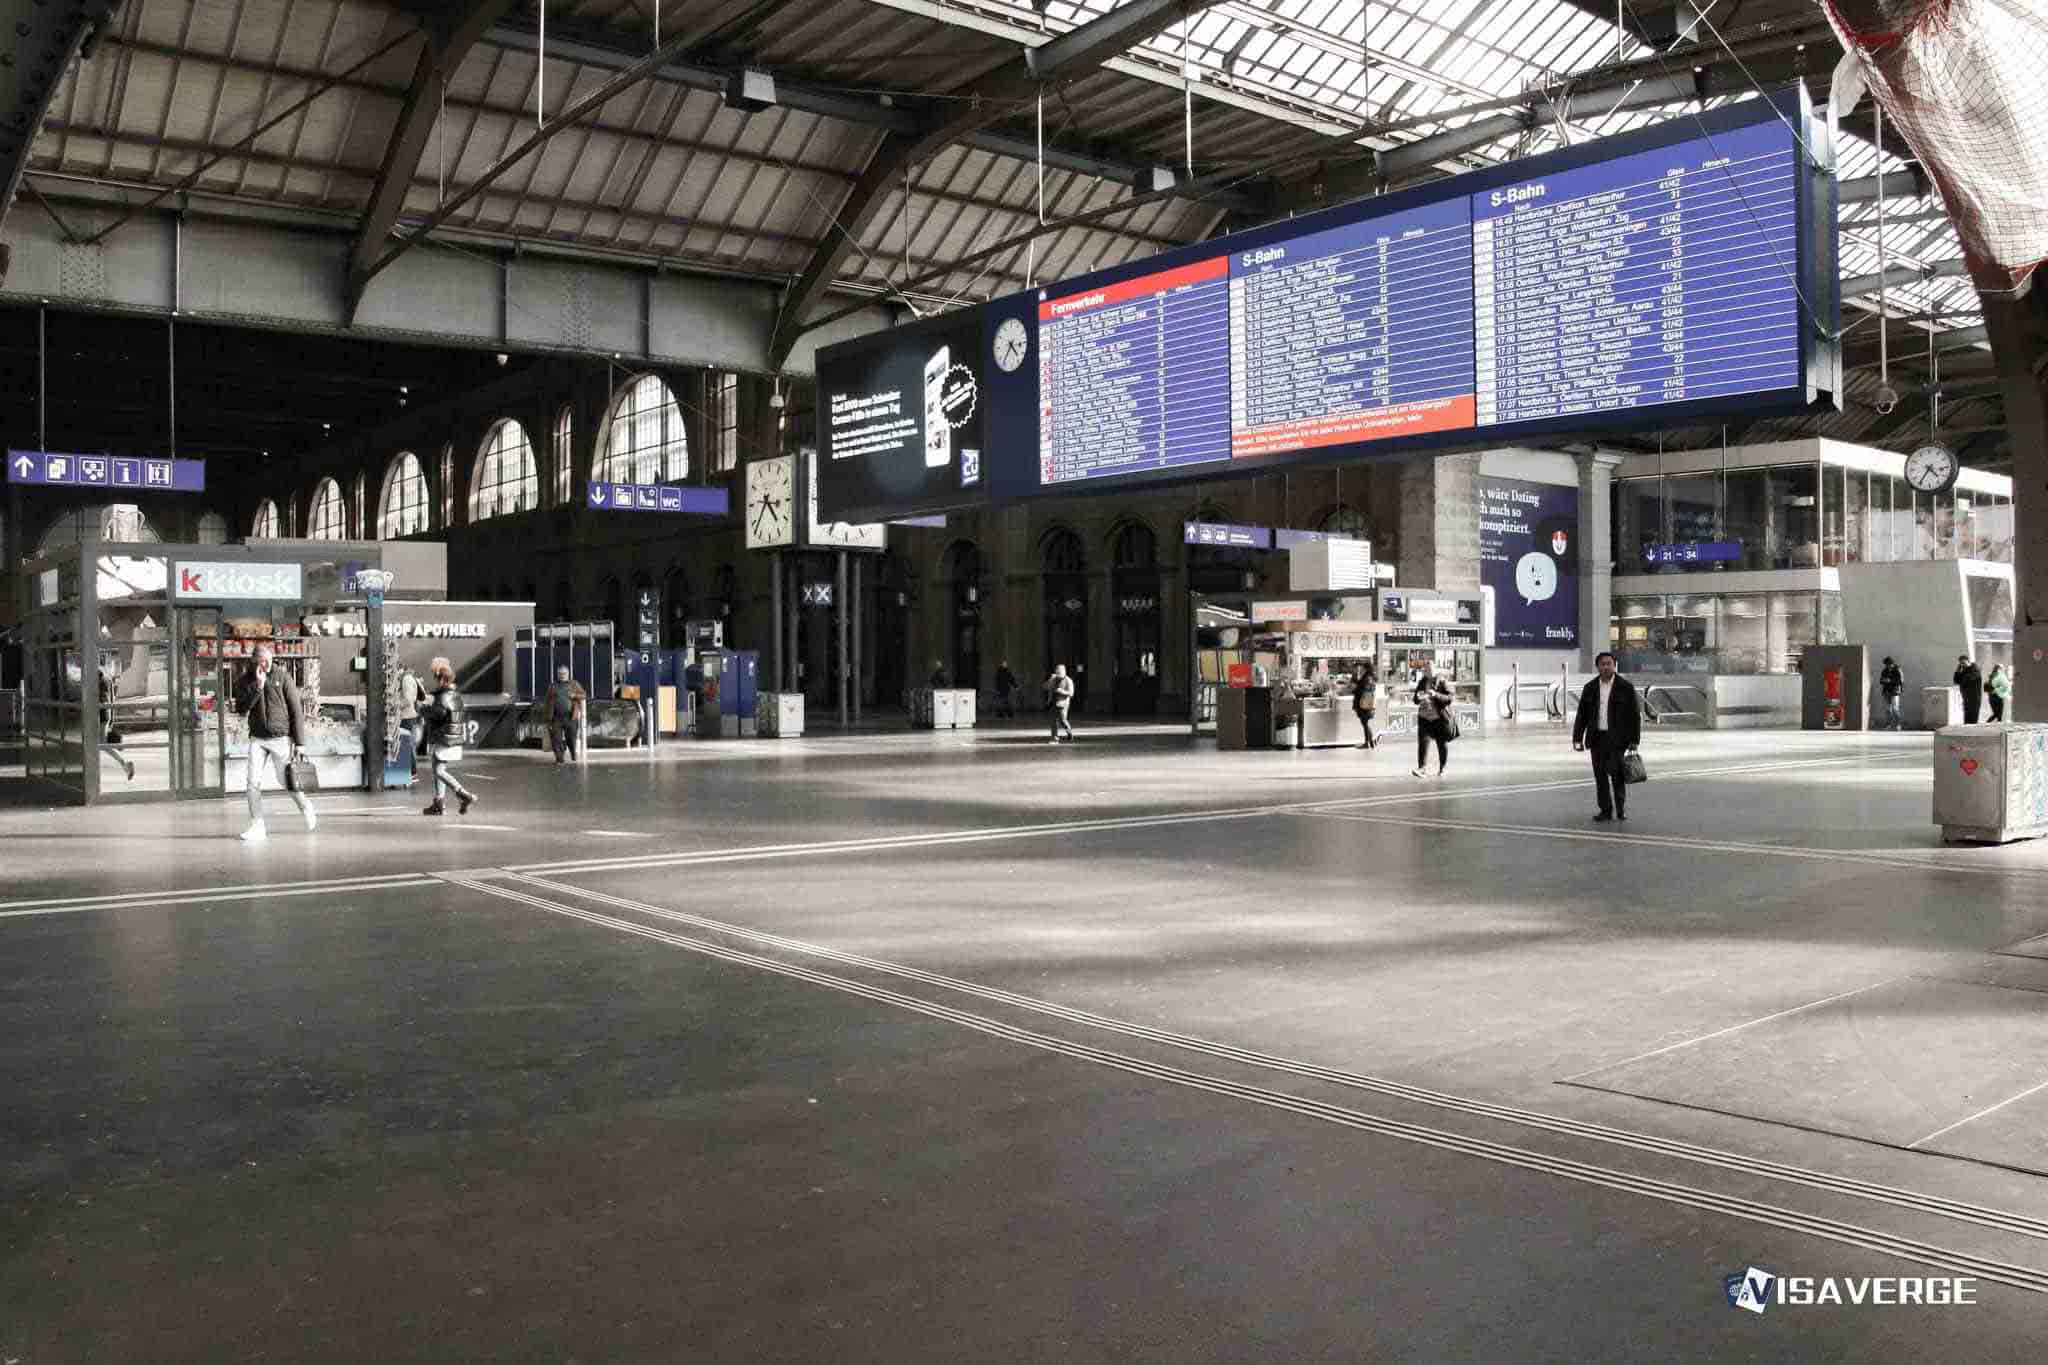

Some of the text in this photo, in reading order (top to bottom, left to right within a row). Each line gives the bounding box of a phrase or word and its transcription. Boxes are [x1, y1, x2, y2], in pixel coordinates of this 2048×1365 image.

[1666, 167, 1685, 178] Gleis
[1491, 183, 1546, 207] S-Bahn
[1515, 203, 1531, 214] Nach
[1243, 247, 1285, 267] S-Bahn
[1051, 293, 1104, 315] Fernverkehr
[663, 499, 679, 508] WC
[1487, 488, 1510, 500] wäre
[1511, 489, 1540, 507] Dating
[1489, 503, 1511, 518] auch
[1511, 509, 1522, 518] so
[1662, 551, 1672, 560] 21
[1686, 551, 1696, 559] 34
[207, 568, 294, 594] kiosk
[414, 623, 487, 637] APOTHEKE
[1545, 625, 1574, 641] frankly.
[1315, 634, 1354, 651] GRILL
